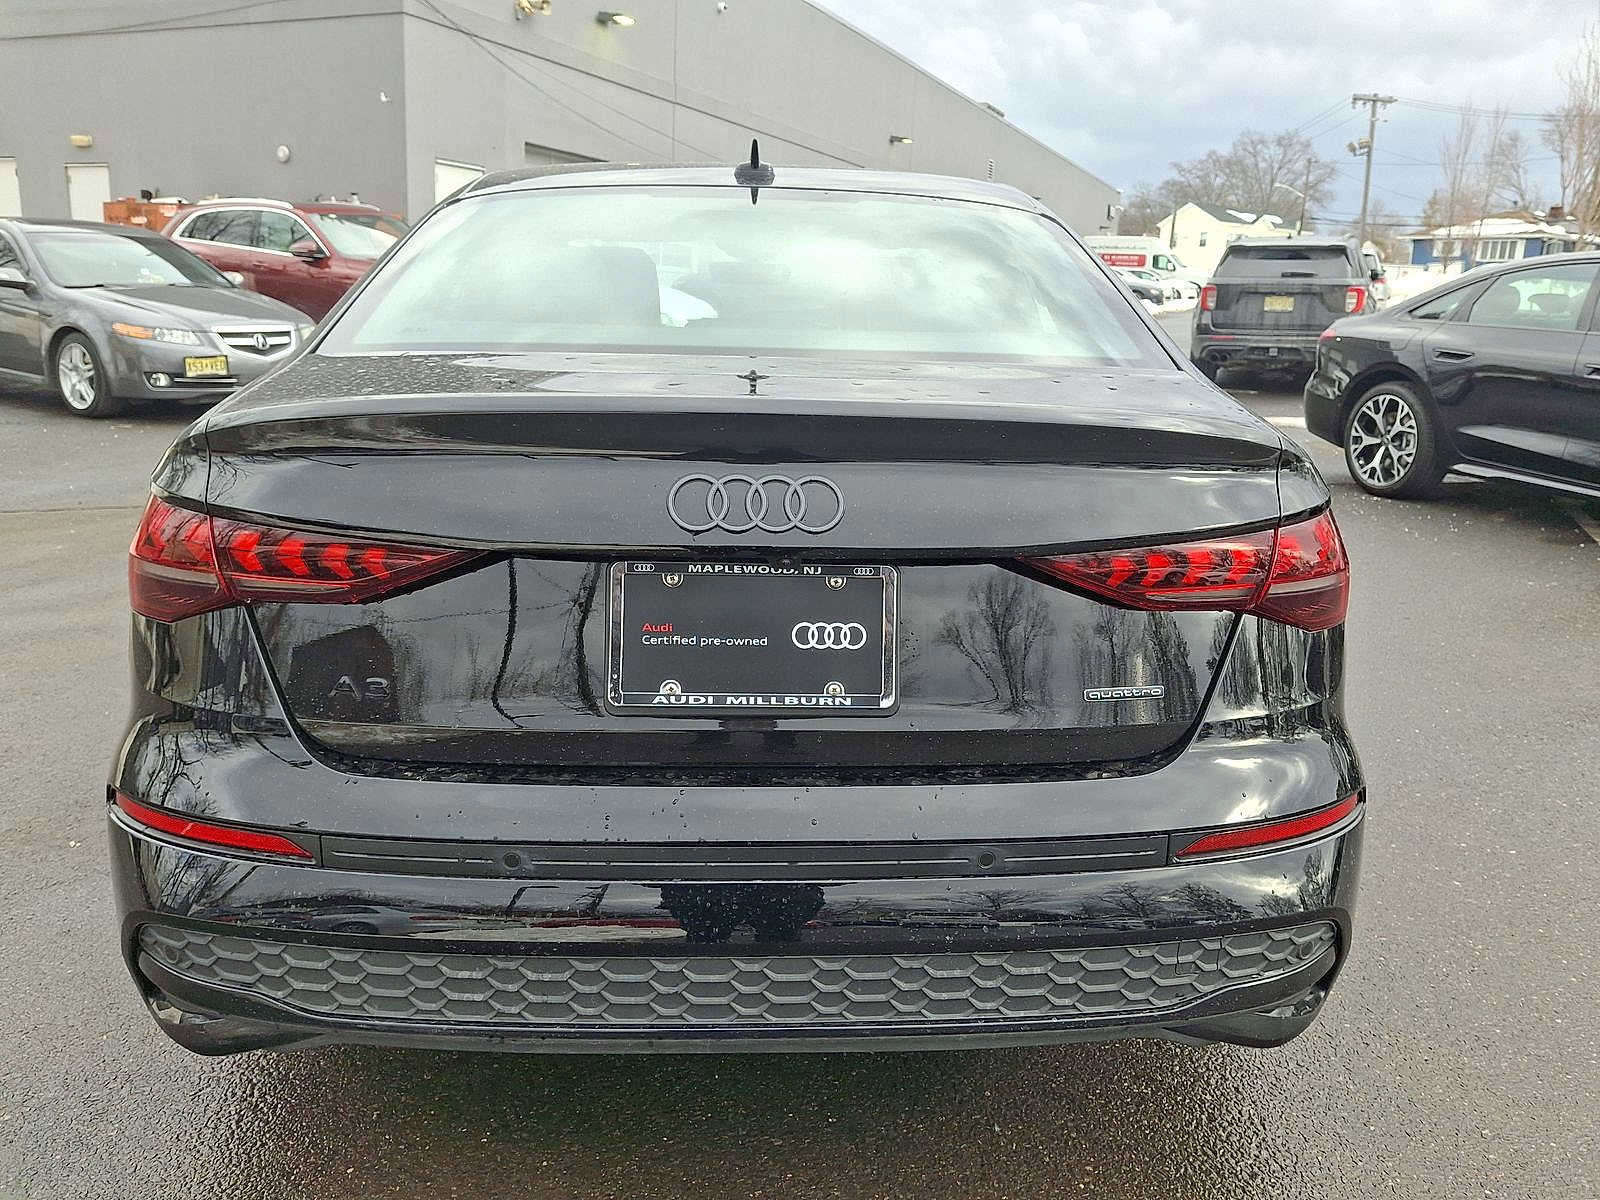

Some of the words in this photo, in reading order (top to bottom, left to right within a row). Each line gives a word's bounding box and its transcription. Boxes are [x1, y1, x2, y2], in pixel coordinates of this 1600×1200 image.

[803, 566, 822, 575] NJ
[641, 623, 673, 632] Audi
[641, 635, 697, 645] Certified
[700, 637, 768, 648] pre-owned
[328, 675, 391, 699] A3
[1088, 687, 1162, 700] quattro
[651, 695, 713, 704] AUDI
[725, 696, 852, 706] MILLBURN
